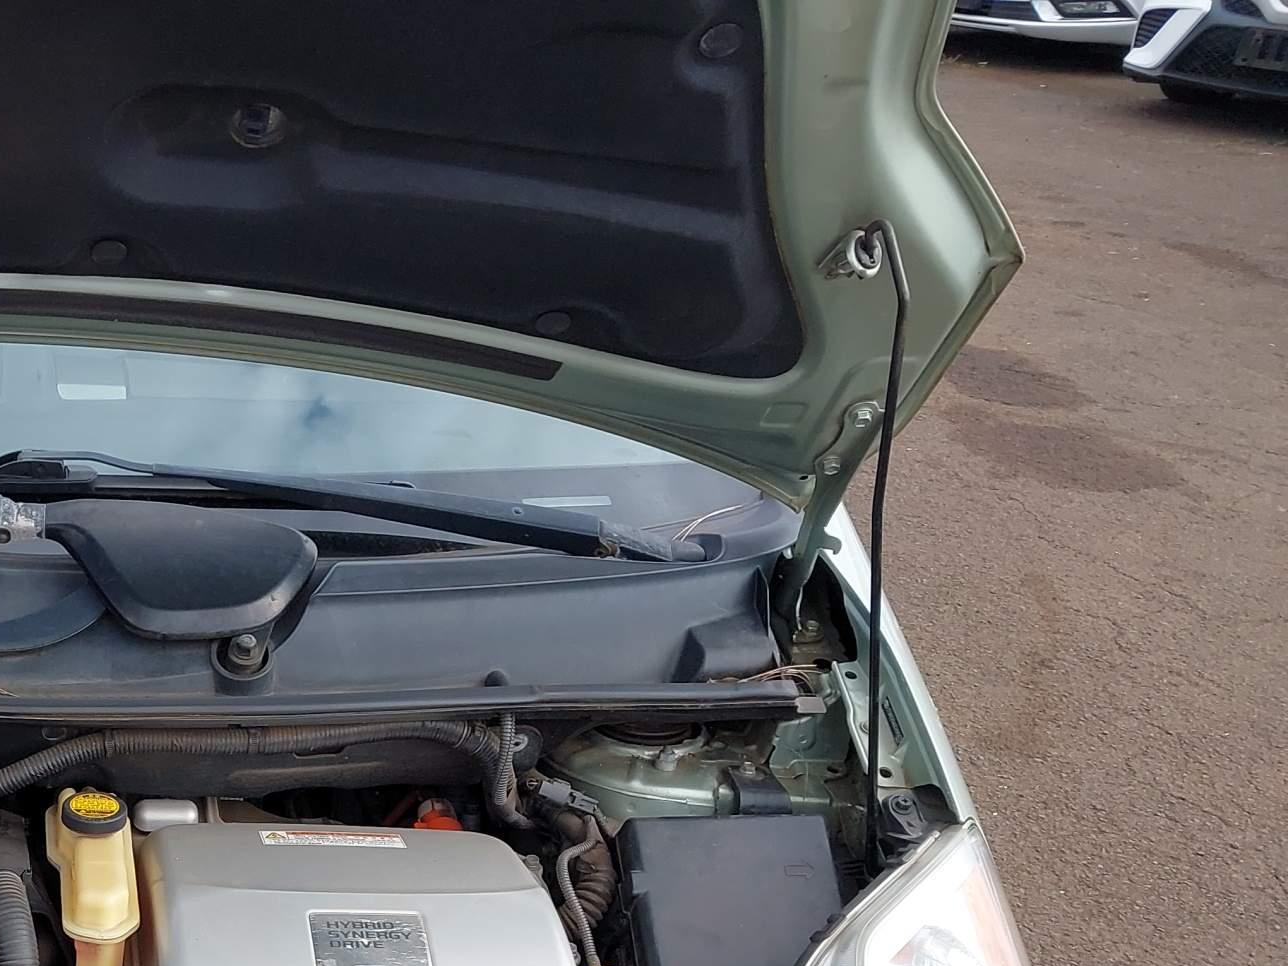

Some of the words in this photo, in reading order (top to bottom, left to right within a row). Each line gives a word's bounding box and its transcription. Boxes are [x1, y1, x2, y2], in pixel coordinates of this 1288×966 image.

[326, 921, 394, 930] HYBRID
[328, 931, 412, 940] SYNERGY
[330, 940, 385, 949] DRIVE
